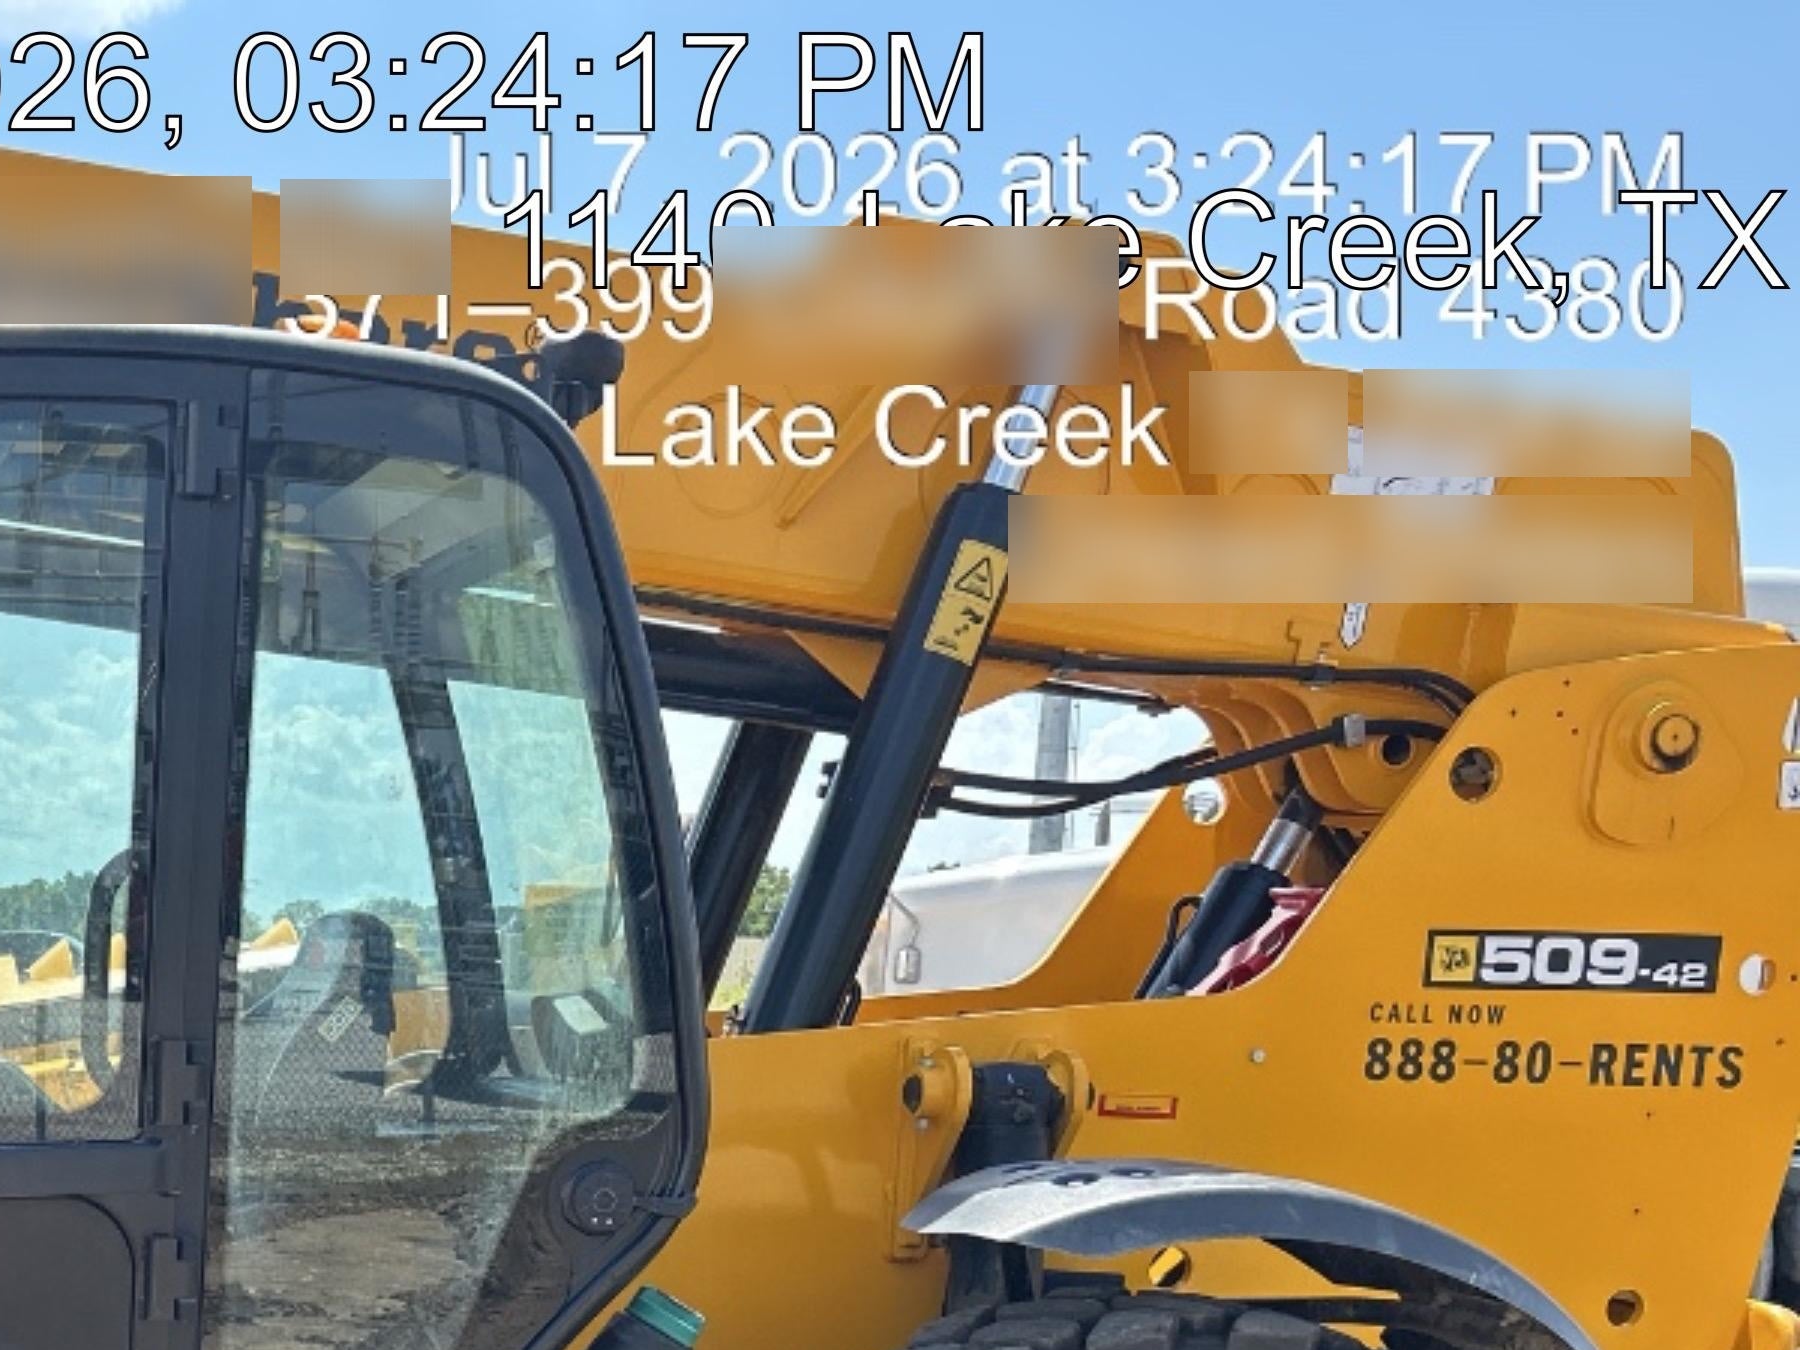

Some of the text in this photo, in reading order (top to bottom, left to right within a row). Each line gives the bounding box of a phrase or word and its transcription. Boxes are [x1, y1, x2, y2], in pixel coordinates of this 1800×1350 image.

[1369, 1001, 1508, 1026] CALL NOW
[1363, 1037, 1745, 1089] 888-80-RENTS
